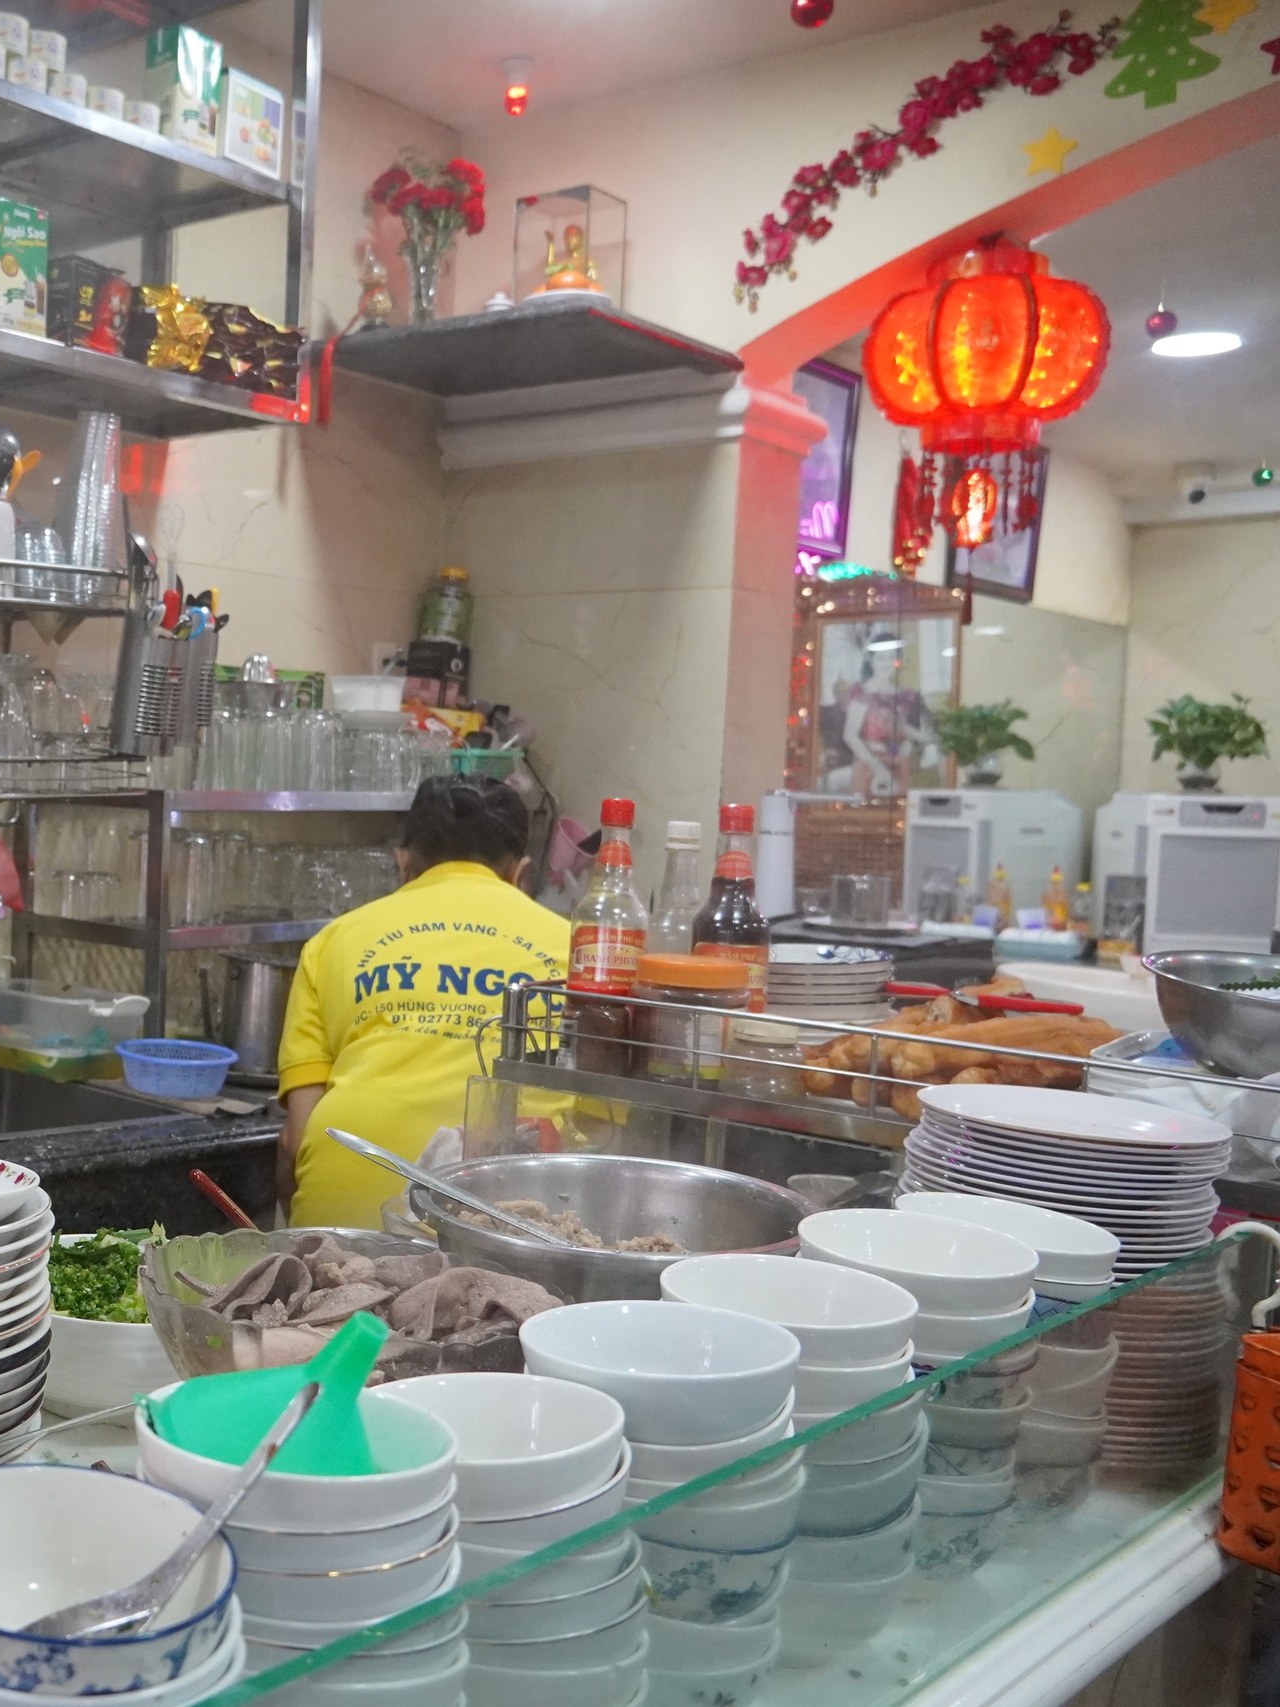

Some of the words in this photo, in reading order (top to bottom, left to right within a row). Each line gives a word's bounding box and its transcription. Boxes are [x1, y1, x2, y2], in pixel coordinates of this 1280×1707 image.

[3, 224, 25, 240] Ngôi
[27, 227, 47, 240] Sao
[408, 922, 446, 934] NAM
[452, 922, 498, 937] VANG
[512, 936, 533, 951] SA
[354, 955, 421, 1004] MỸ
[418, 1014, 461, 1025] 02773
